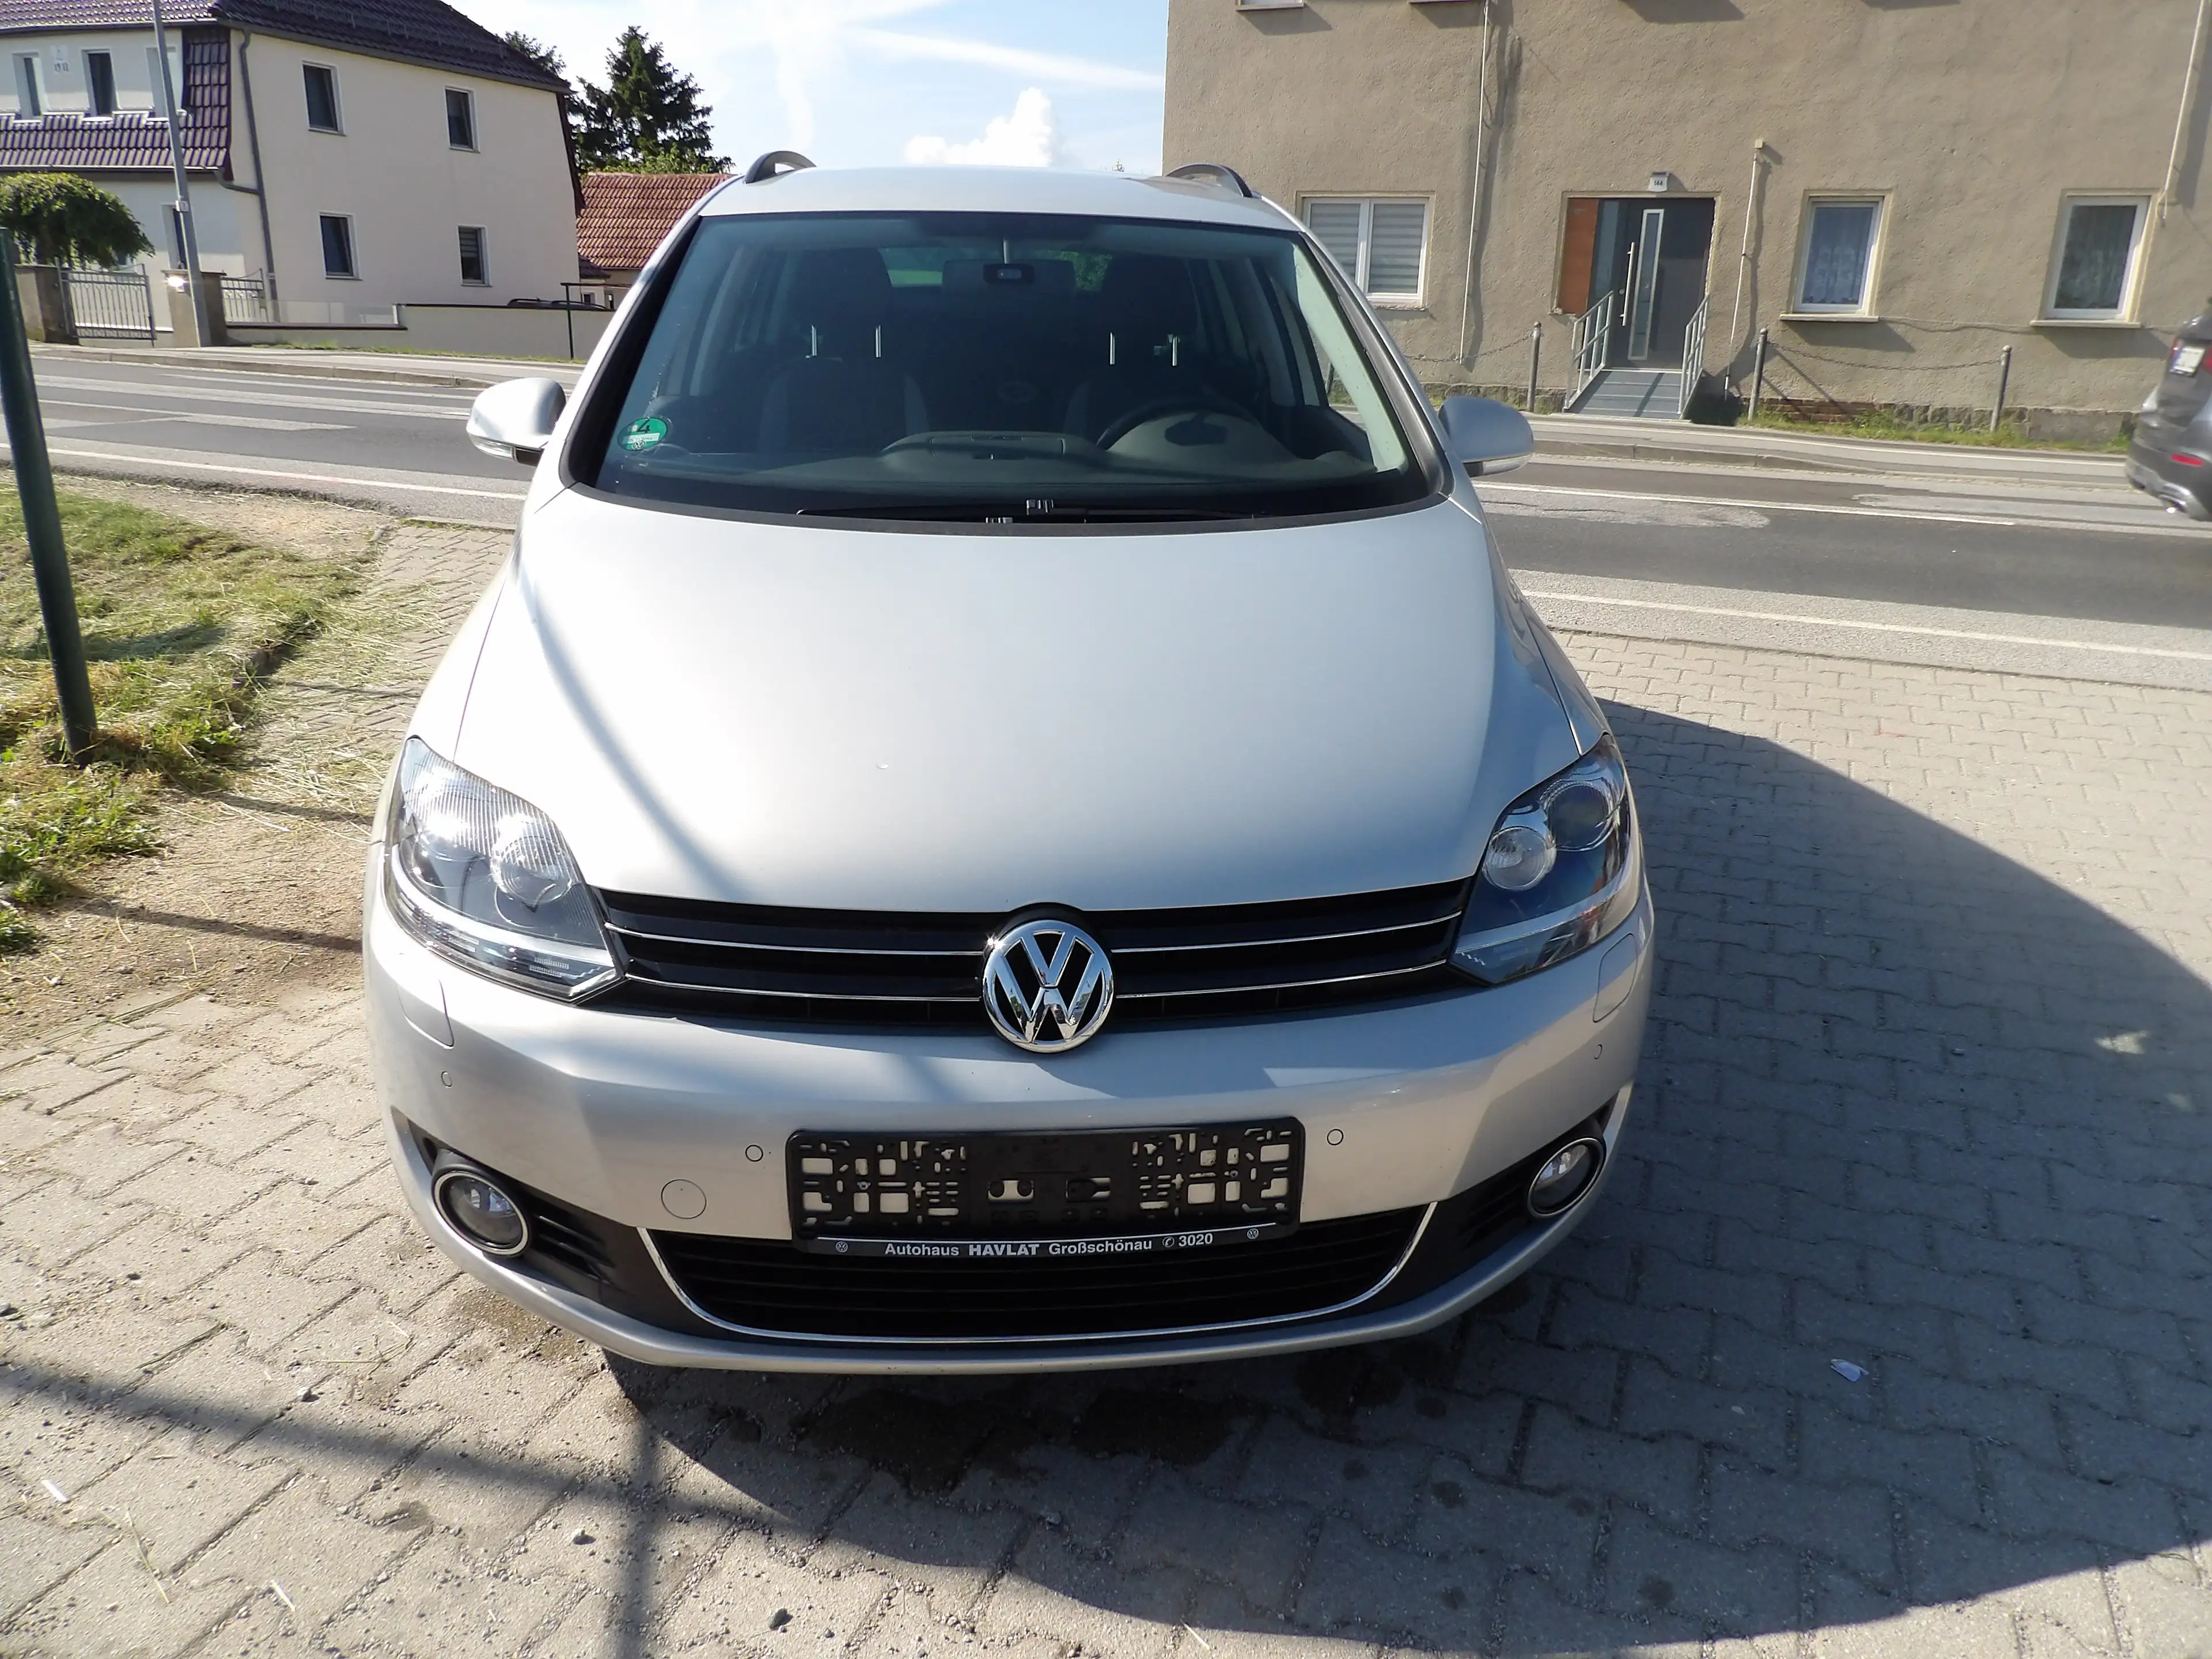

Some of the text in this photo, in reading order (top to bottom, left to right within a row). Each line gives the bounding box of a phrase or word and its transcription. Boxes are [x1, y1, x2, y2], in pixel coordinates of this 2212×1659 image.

[637, 419, 650, 433] 4
[988, 928, 1107, 1046] VW
[885, 1233, 1213, 1256] Autohaus HAVLAT Großschönau 3020
